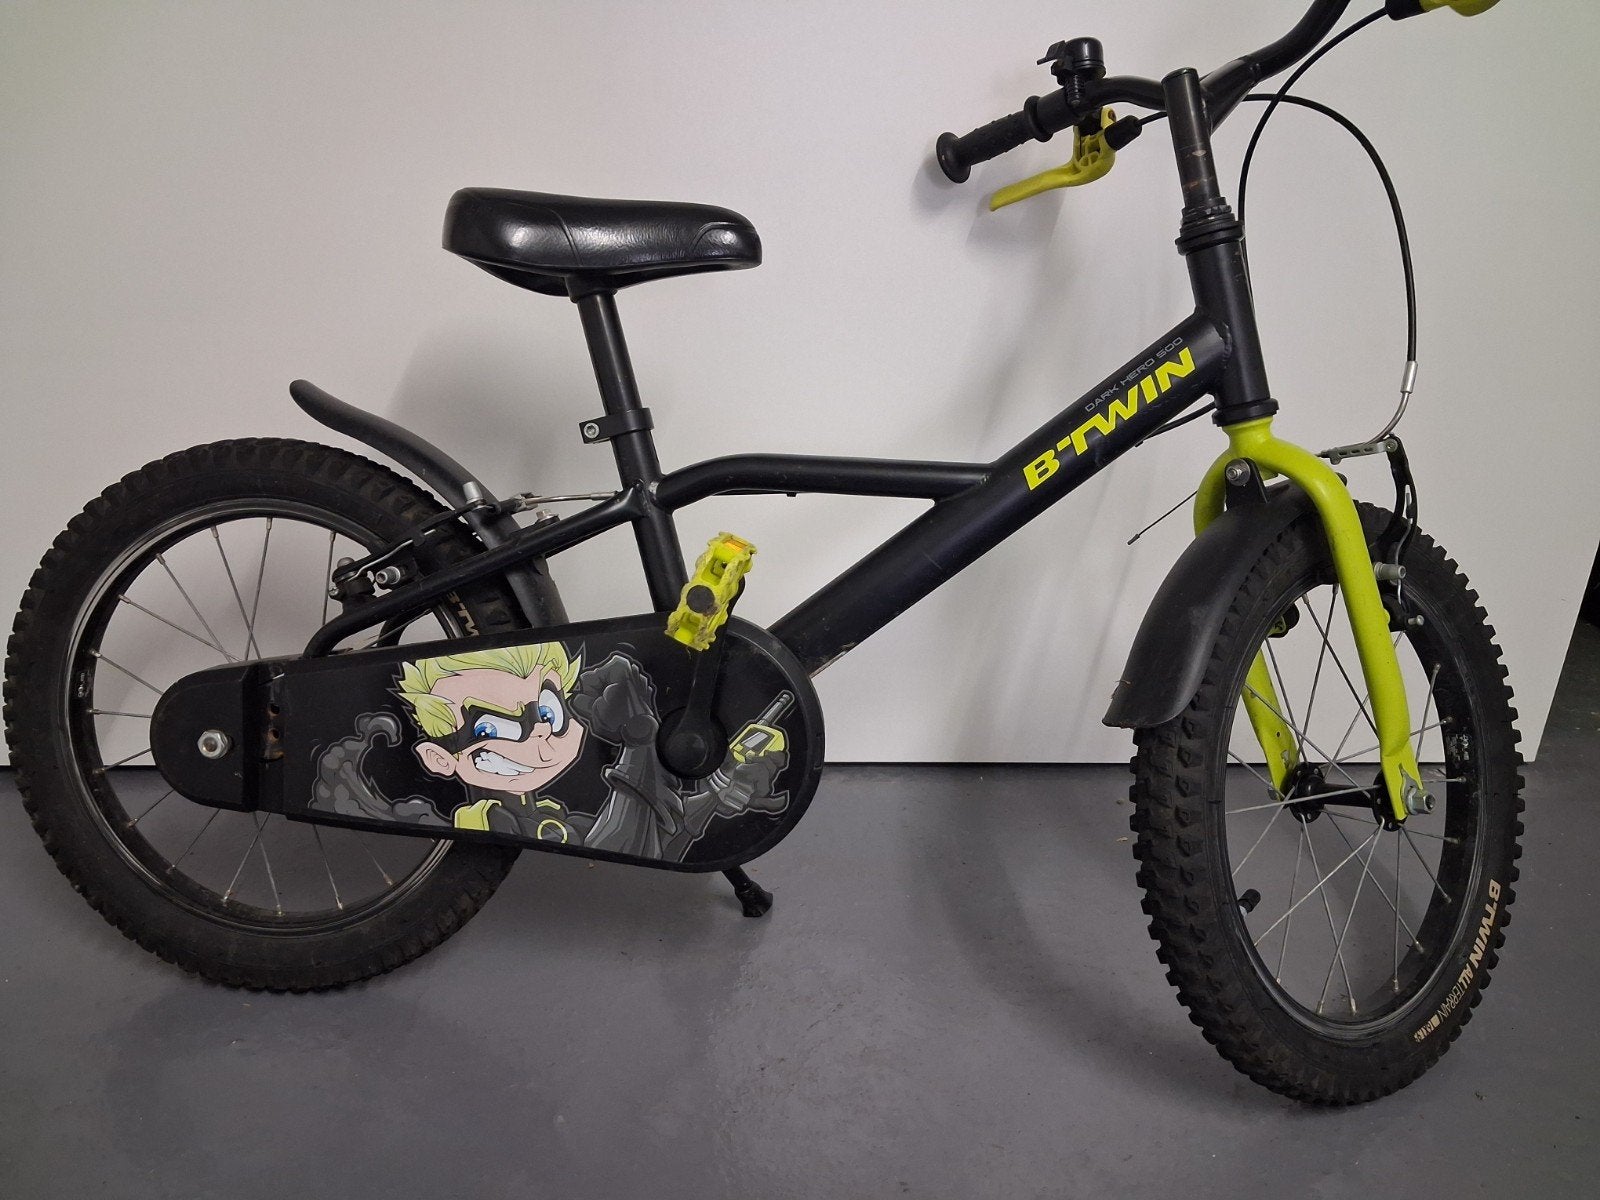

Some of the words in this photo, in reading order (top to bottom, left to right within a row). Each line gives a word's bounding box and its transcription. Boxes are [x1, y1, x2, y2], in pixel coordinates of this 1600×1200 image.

[1084, 383, 1119, 413] DARK
[1120, 357, 1155, 386] HERO
[1156, 336, 1183, 358] 500
